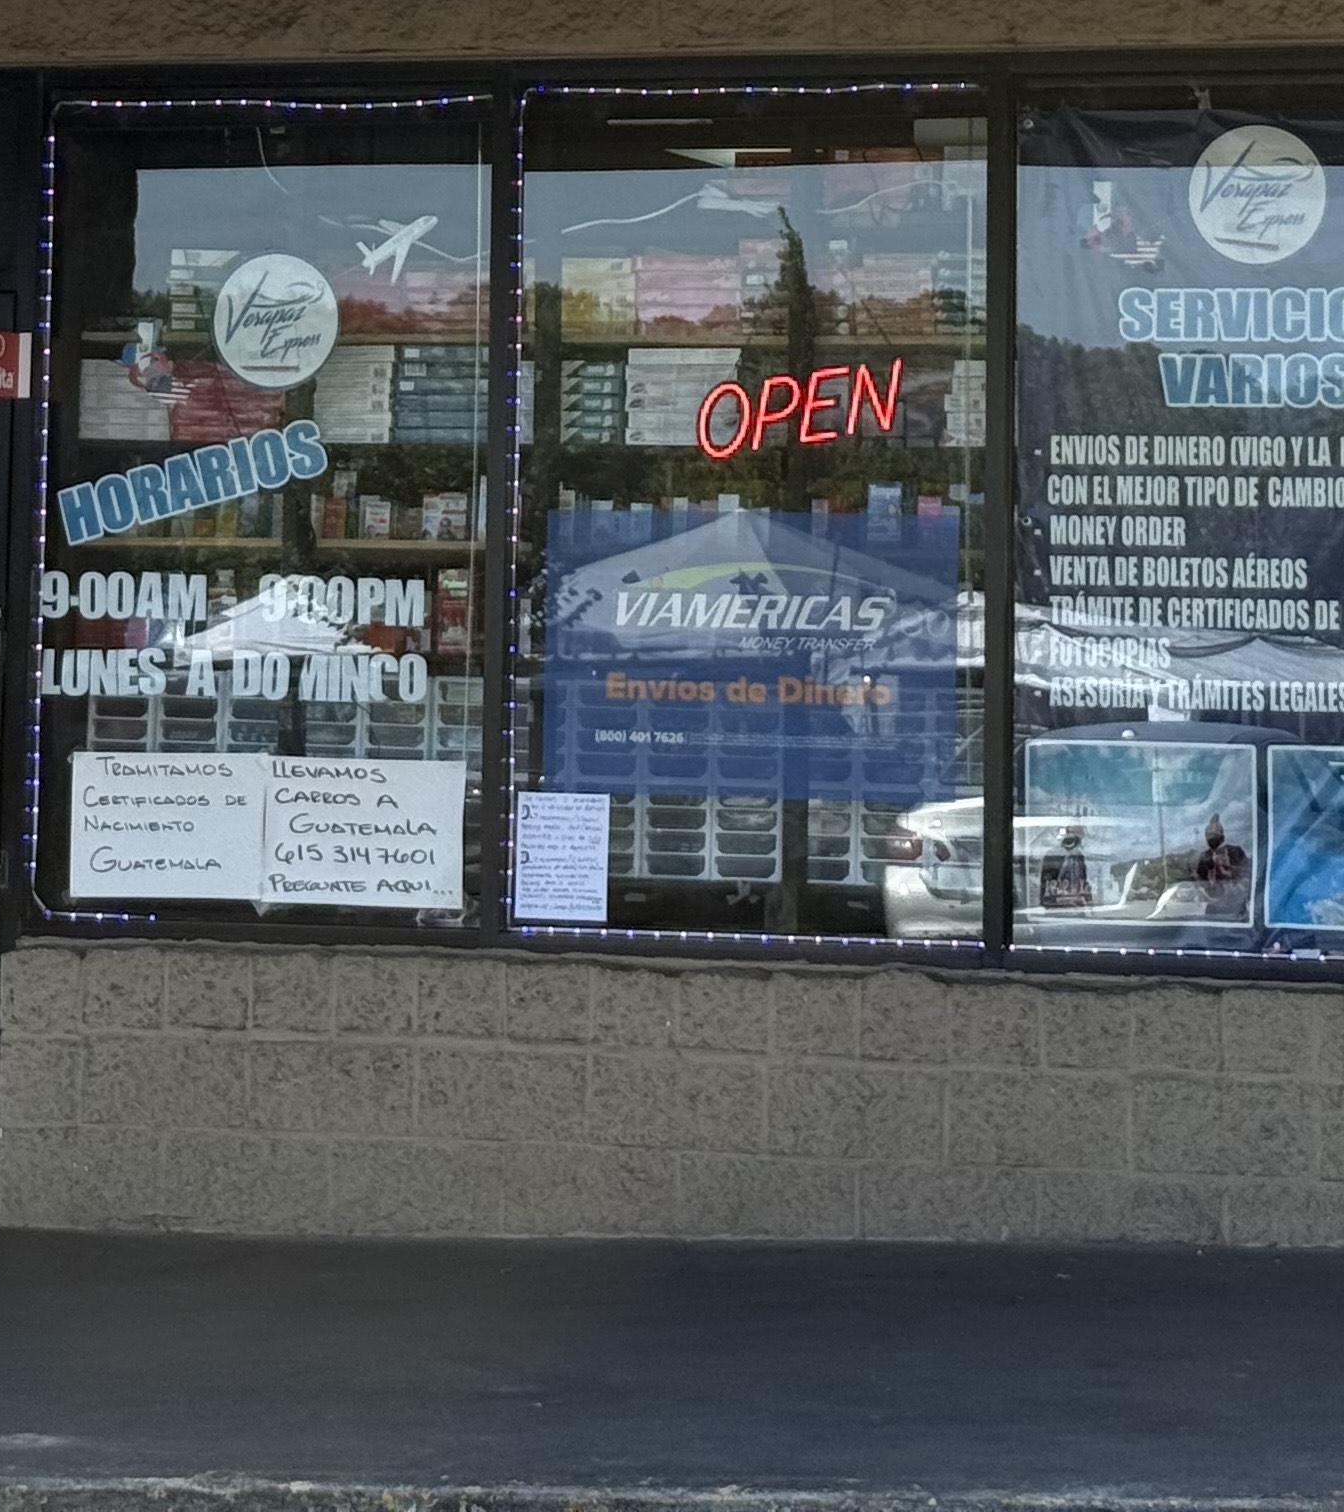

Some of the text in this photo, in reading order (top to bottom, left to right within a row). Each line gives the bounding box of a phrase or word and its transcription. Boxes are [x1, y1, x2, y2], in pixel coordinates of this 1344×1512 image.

[1200, 140, 1291, 217] Verapaz
[225, 272, 308, 346] Verapaz
[697, 356, 902, 459] OPEN
[1050, 435, 1121, 466] ENVIOS
[1125, 437, 1149, 466] DE
[1155, 437, 1225, 466] DINERO
[1231, 437, 1286, 467] (VIGO
[1292, 438, 1304, 466] Y
[1307, 438, 1331, 467] LA
[58, 419, 329, 546] HORARIOS
[1047, 474, 1088, 506] CON
[1093, 476, 1112, 505] EL
[1117, 477, 1180, 506] MEJOR
[1185, 477, 1228, 506] TIPO
[1235, 477, 1259, 506] DE
[1049, 515, 1186, 546] MONEY ORDER
[1049, 553, 1308, 588] VENTA DE BOLETOS AÉREOS
[616, 591, 891, 631] VIAMERICAS
[1049, 591, 1135, 627] TRÁMITE
[1139, 597, 1164, 627] DE
[1167, 598, 1310, 630] CERTIFICADOS
[1315, 600, 1339, 630] DE
[738, 636, 877, 651] MONEY TRANSFER
[41, 647, 167, 696] LUNES
[186, 649, 217, 697] A
[606, 671, 891, 705] Envíos de Dinero
[1150, 677, 1163, 707] Y
[1167, 673, 1265, 711] TRÁMITES
[225, 795, 247, 806] DE
[275, 788, 399, 809] CARROS A
[275, 843, 323, 865] 615
[333, 846, 370, 865] 314
